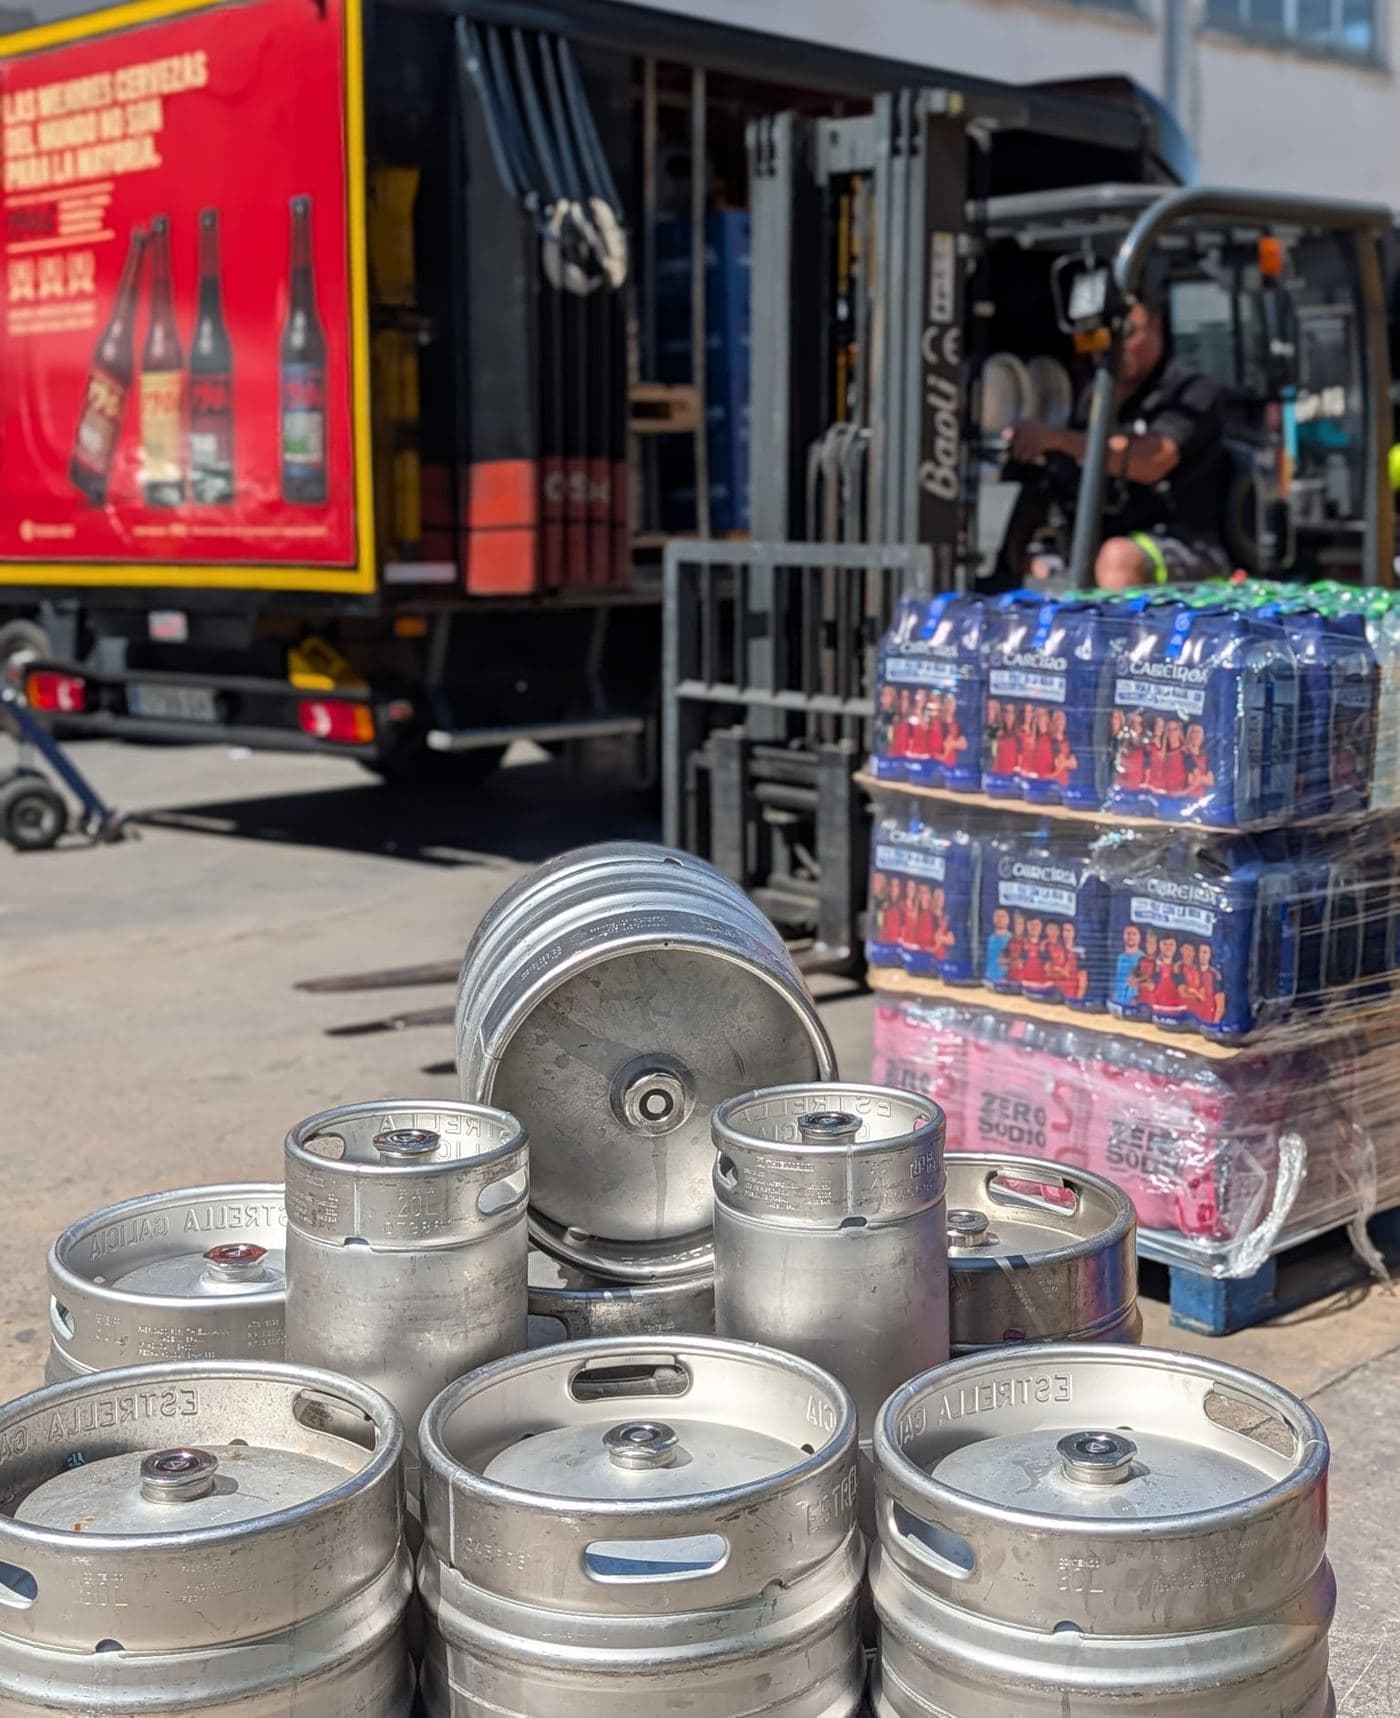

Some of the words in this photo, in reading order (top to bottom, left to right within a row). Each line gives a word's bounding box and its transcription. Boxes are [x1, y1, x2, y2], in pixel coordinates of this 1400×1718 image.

[920, 372, 960, 499] Baoli
[981, 1092, 1047, 1128] ZERO
[978, 1116, 1047, 1149] SODIO
